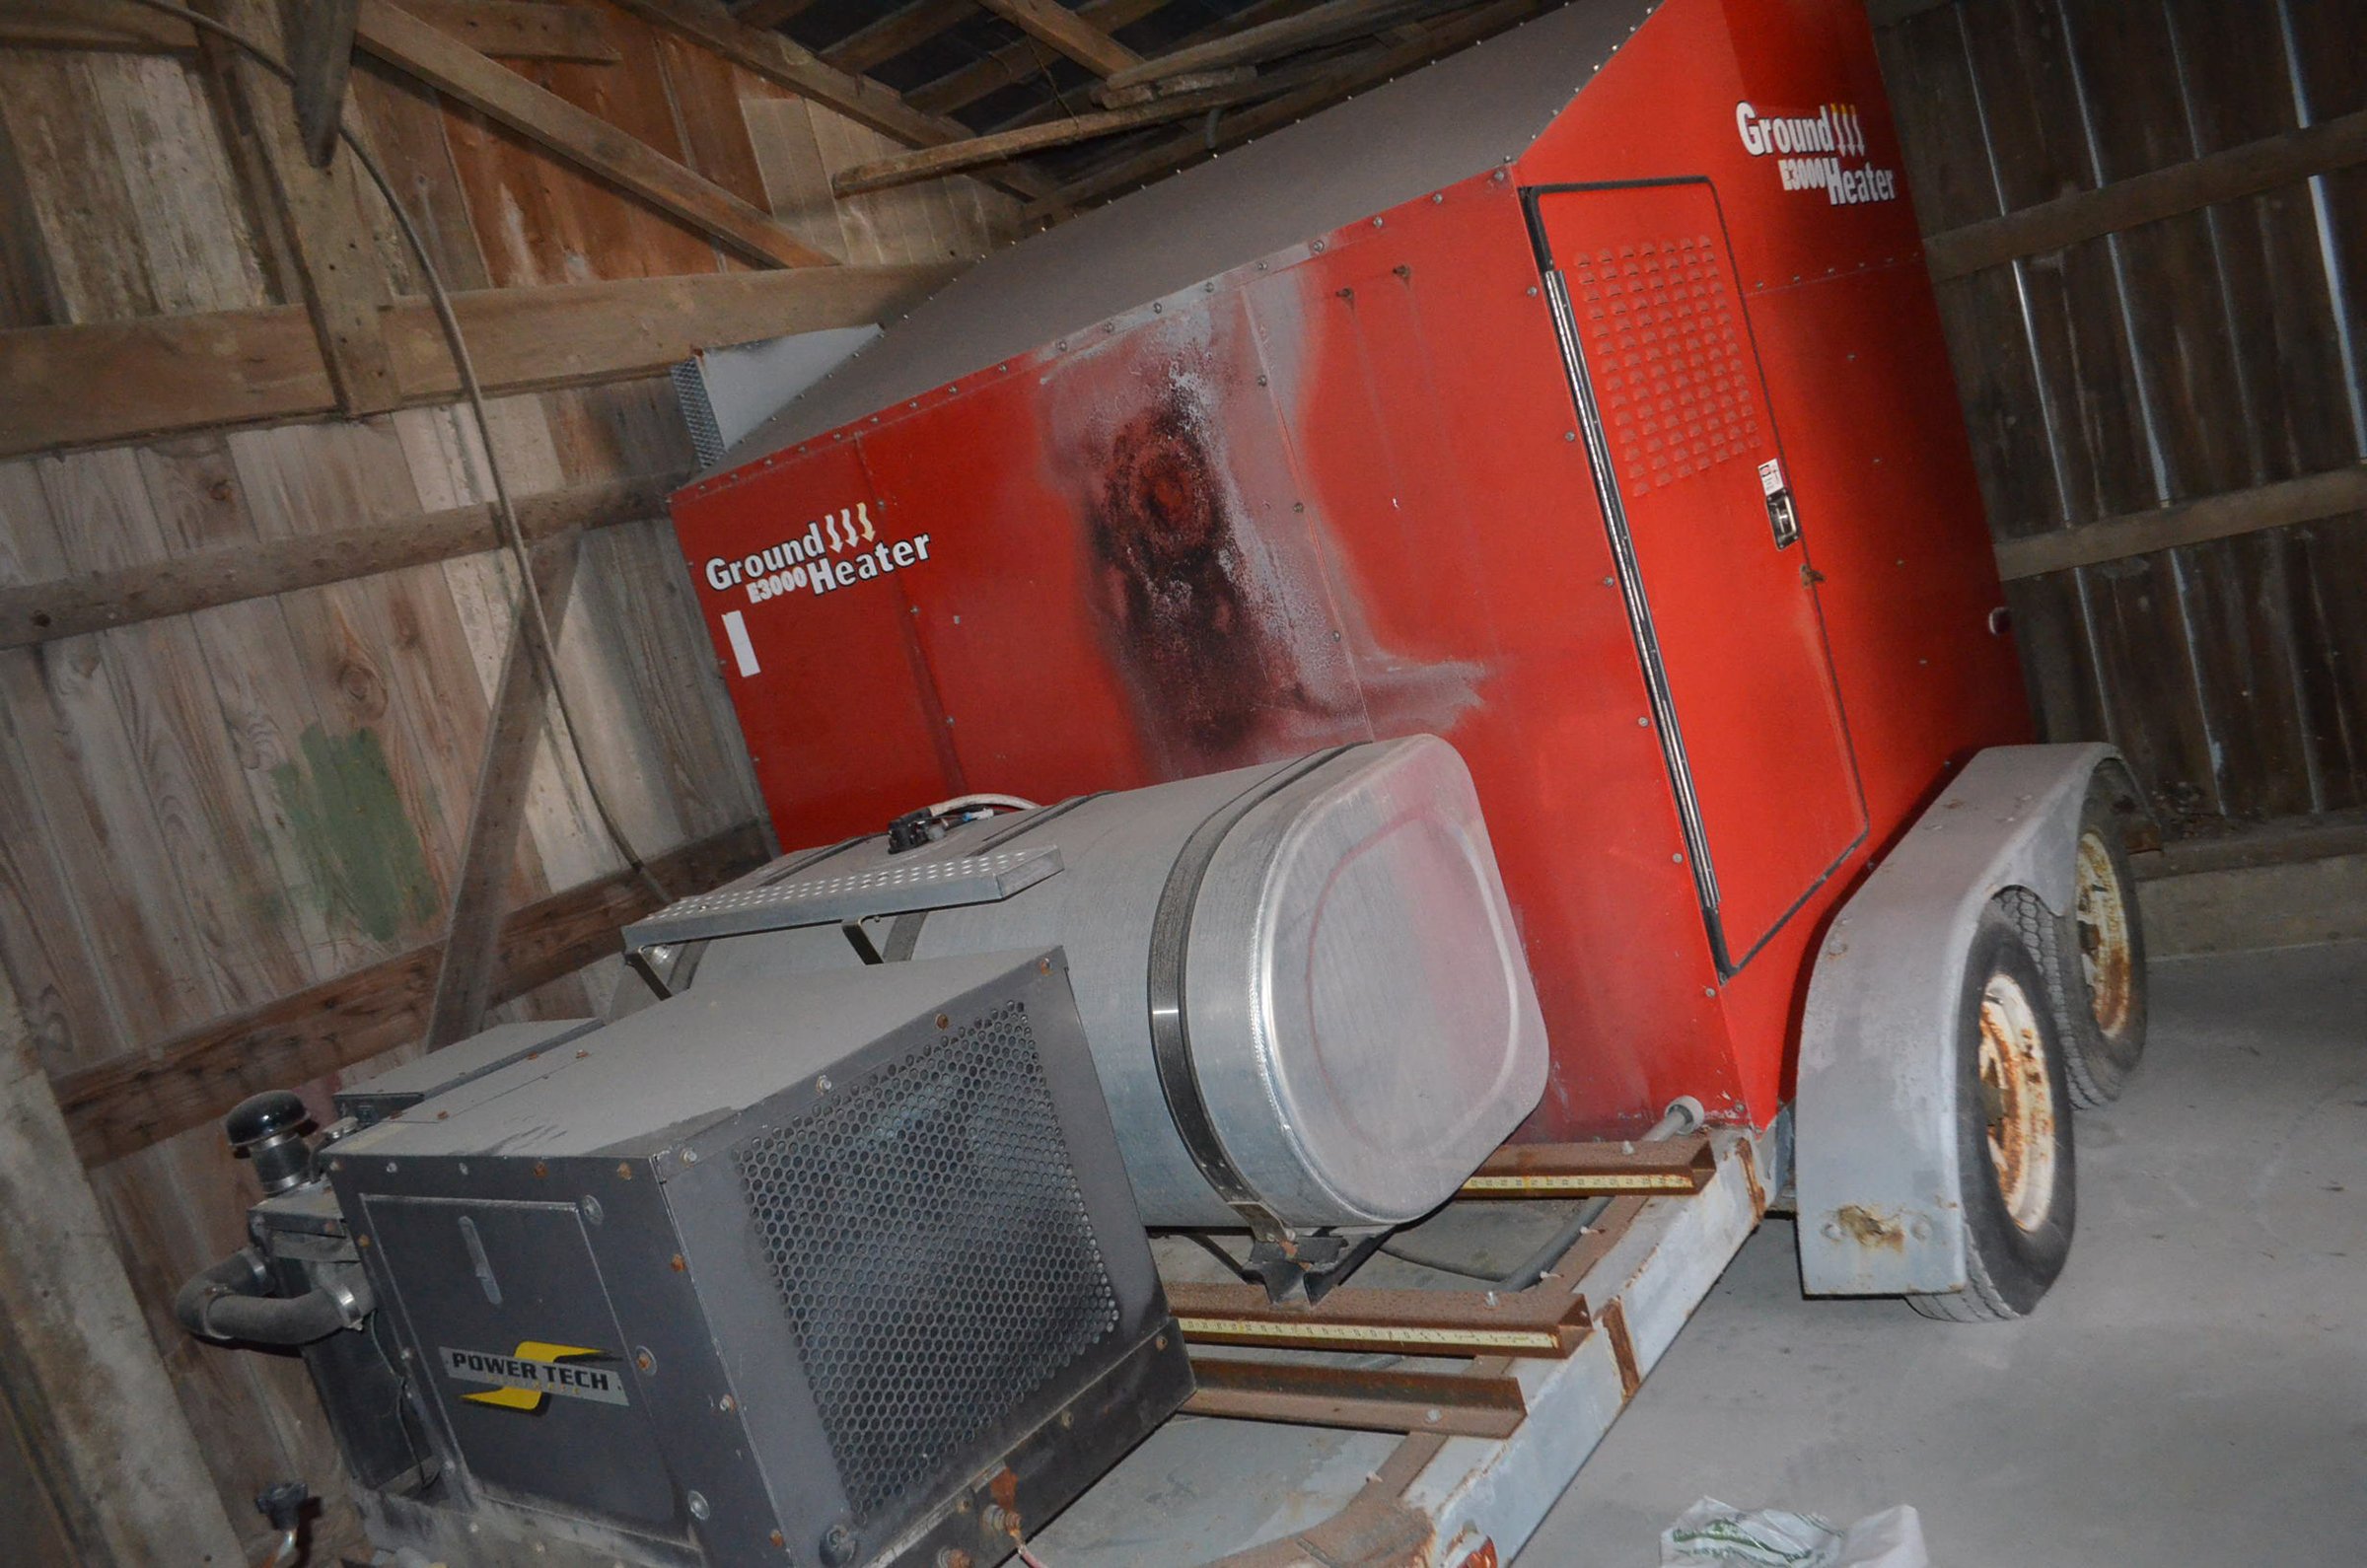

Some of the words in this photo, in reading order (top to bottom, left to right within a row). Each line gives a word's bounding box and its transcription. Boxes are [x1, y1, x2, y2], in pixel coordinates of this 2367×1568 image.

[1737, 102, 1834, 155] Ground
[1825, 158, 1896, 206] Heater
[705, 522, 825, 592] Ground
[746, 566, 809, 605] E3000
[807, 534, 930, 596] Heater
[452, 1352, 538, 1381] POWER
[542, 1365, 610, 1391] TECH
